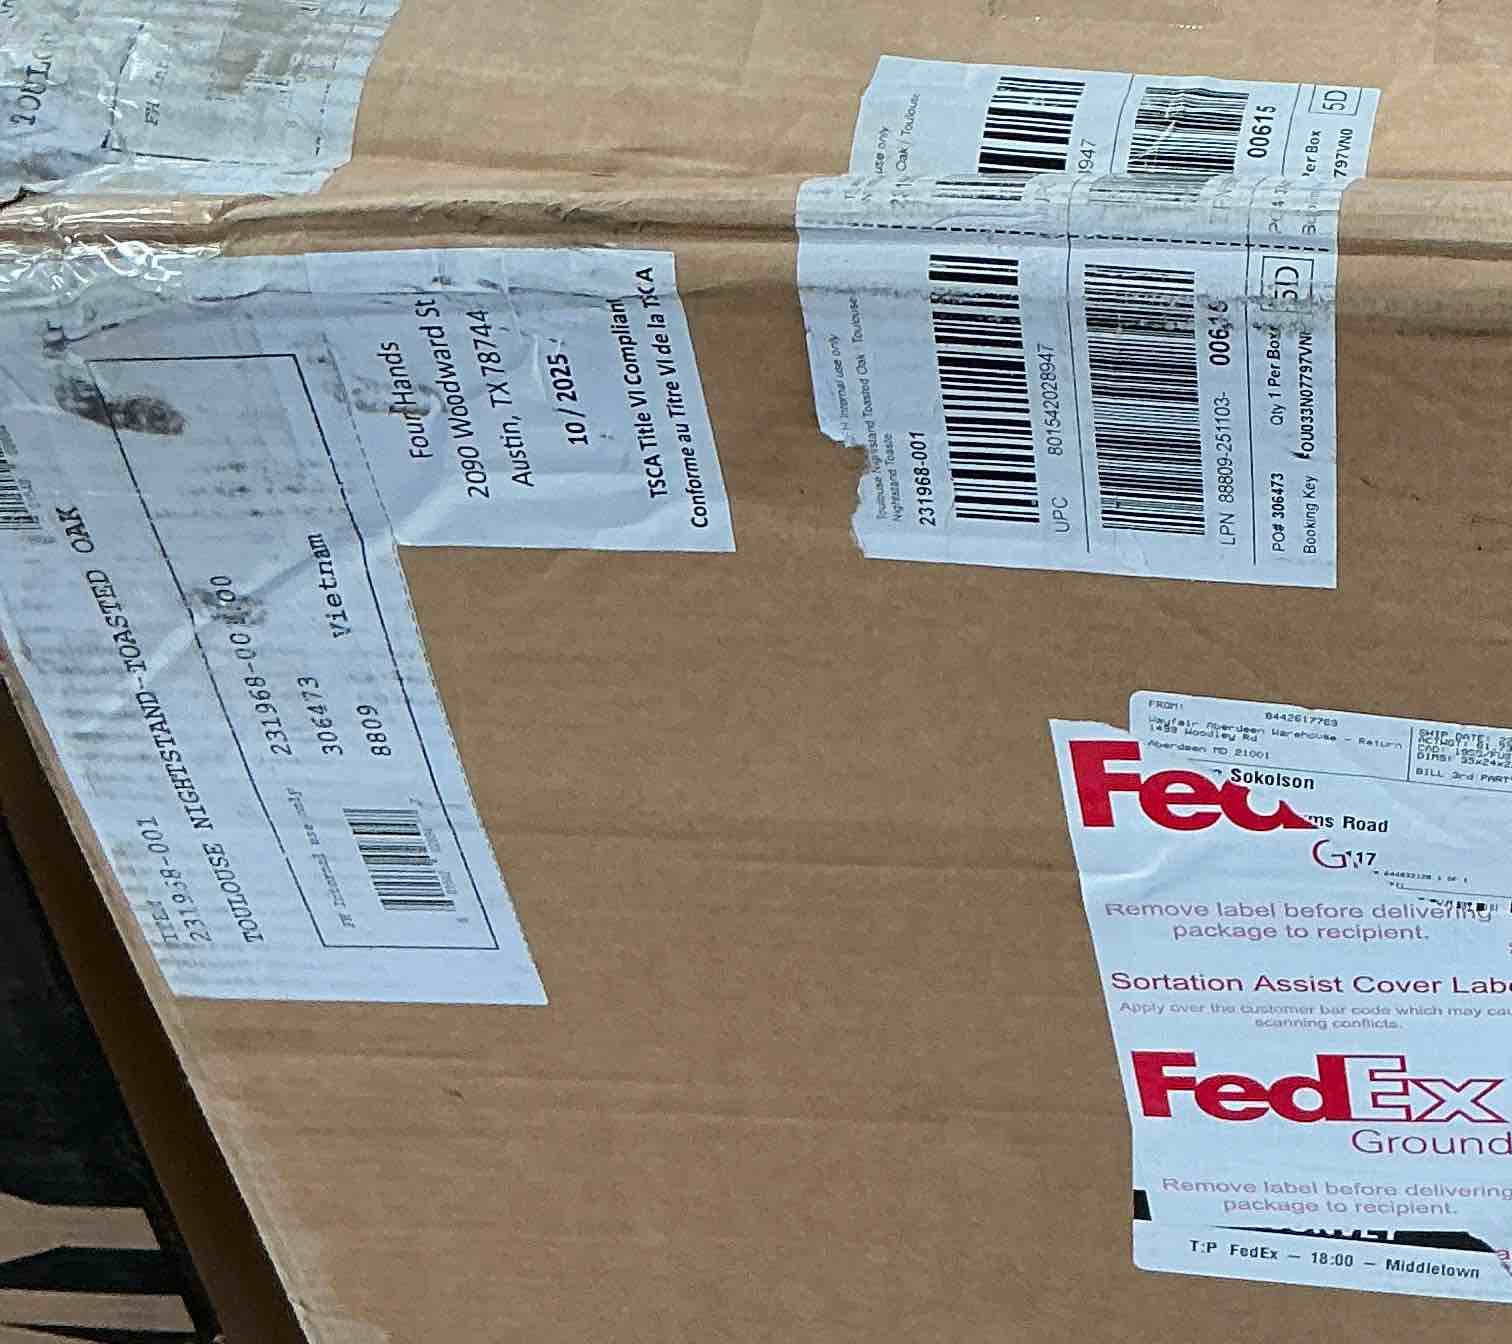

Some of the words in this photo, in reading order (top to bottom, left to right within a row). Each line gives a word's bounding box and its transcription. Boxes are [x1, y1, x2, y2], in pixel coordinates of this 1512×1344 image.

[1322, 90, 1349, 111] 5D
[1247, 105, 1276, 158] 00615
[1305, 129, 1321, 153] Box
[414, 299, 440, 317] St
[646, 314, 664, 329] la
[466, 309, 500, 377] 78744
[652, 333, 671, 355] de
[377, 341, 418, 405] Hands
[420, 326, 475, 438] Woodward
[547, 354, 578, 402] 2025
[659, 359, 677, 376] VI
[1268, 364, 1281, 387] Per
[488, 381, 513, 408] TX
[629, 390, 647, 408] VI
[665, 381, 686, 417] Titre
[1037, 342, 1064, 456] 801542028947
[634, 413, 660, 450] Title
[1269, 404, 1285, 425] Qty
[401, 412, 433, 458] Four
[565, 422, 589, 445] 10
[676, 423, 693, 443] au
[500, 415, 534, 487] Austin,
[457, 446, 490, 499] 2090
[643, 454, 669, 498] TSCA
[682, 447, 708, 528] Conforme
[908, 431, 937, 526] 231968-001
[1303, 475, 1317, 499] Key
[1271, 472, 1285, 519] 306473
[55, 505, 96, 555] OAK
[1050, 496, 1070, 533] UPC
[1219, 513, 1236, 545] LPN
[1302, 502, 1320, 554] Booking
[1271, 522, 1286, 552] PO#
[305, 532, 352, 639] Vietnam
[85, 568, 215, 831] NIGHTSTAND-TOASTED
[296, 674, 344, 756] 306473
[356, 703, 392, 757] 8809
[1230, 768, 1315, 790] Sokolson
[1342, 816, 1389, 833] Road
[201, 841, 265, 944] TOULOUSE
[1105, 901, 1209, 917] Remove
[1216, 901, 1278, 919] label
[1285, 902, 1363, 920] before
[1173, 923, 1278, 941] package
[1285, 925, 1309, 939] to
[1317, 925, 1429, 942] recipient.
[1111, 971, 1244, 992] Sortation
[1253, 974, 1342, 994] Assist
[1352, 976, 1441, 995] Cover
[1130, 1050, 1511, 1124] FedEx
[1352, 1128, 1512, 1156] Ground
[1161, 1176, 1257, 1195] Remove
[1263, 1178, 1318, 1196] label
[1325, 1181, 1398, 1198] before
[1223, 1196, 1319, 1216] package
[1326, 1199, 1348, 1215] to
[1354, 1199, 1457, 1217] recipient.
[1229, 1244, 1277, 1260] FedEx
[1311, 1251, 1354, 1268] 18:00
[1385, 1257, 1480, 1279] Middletown
